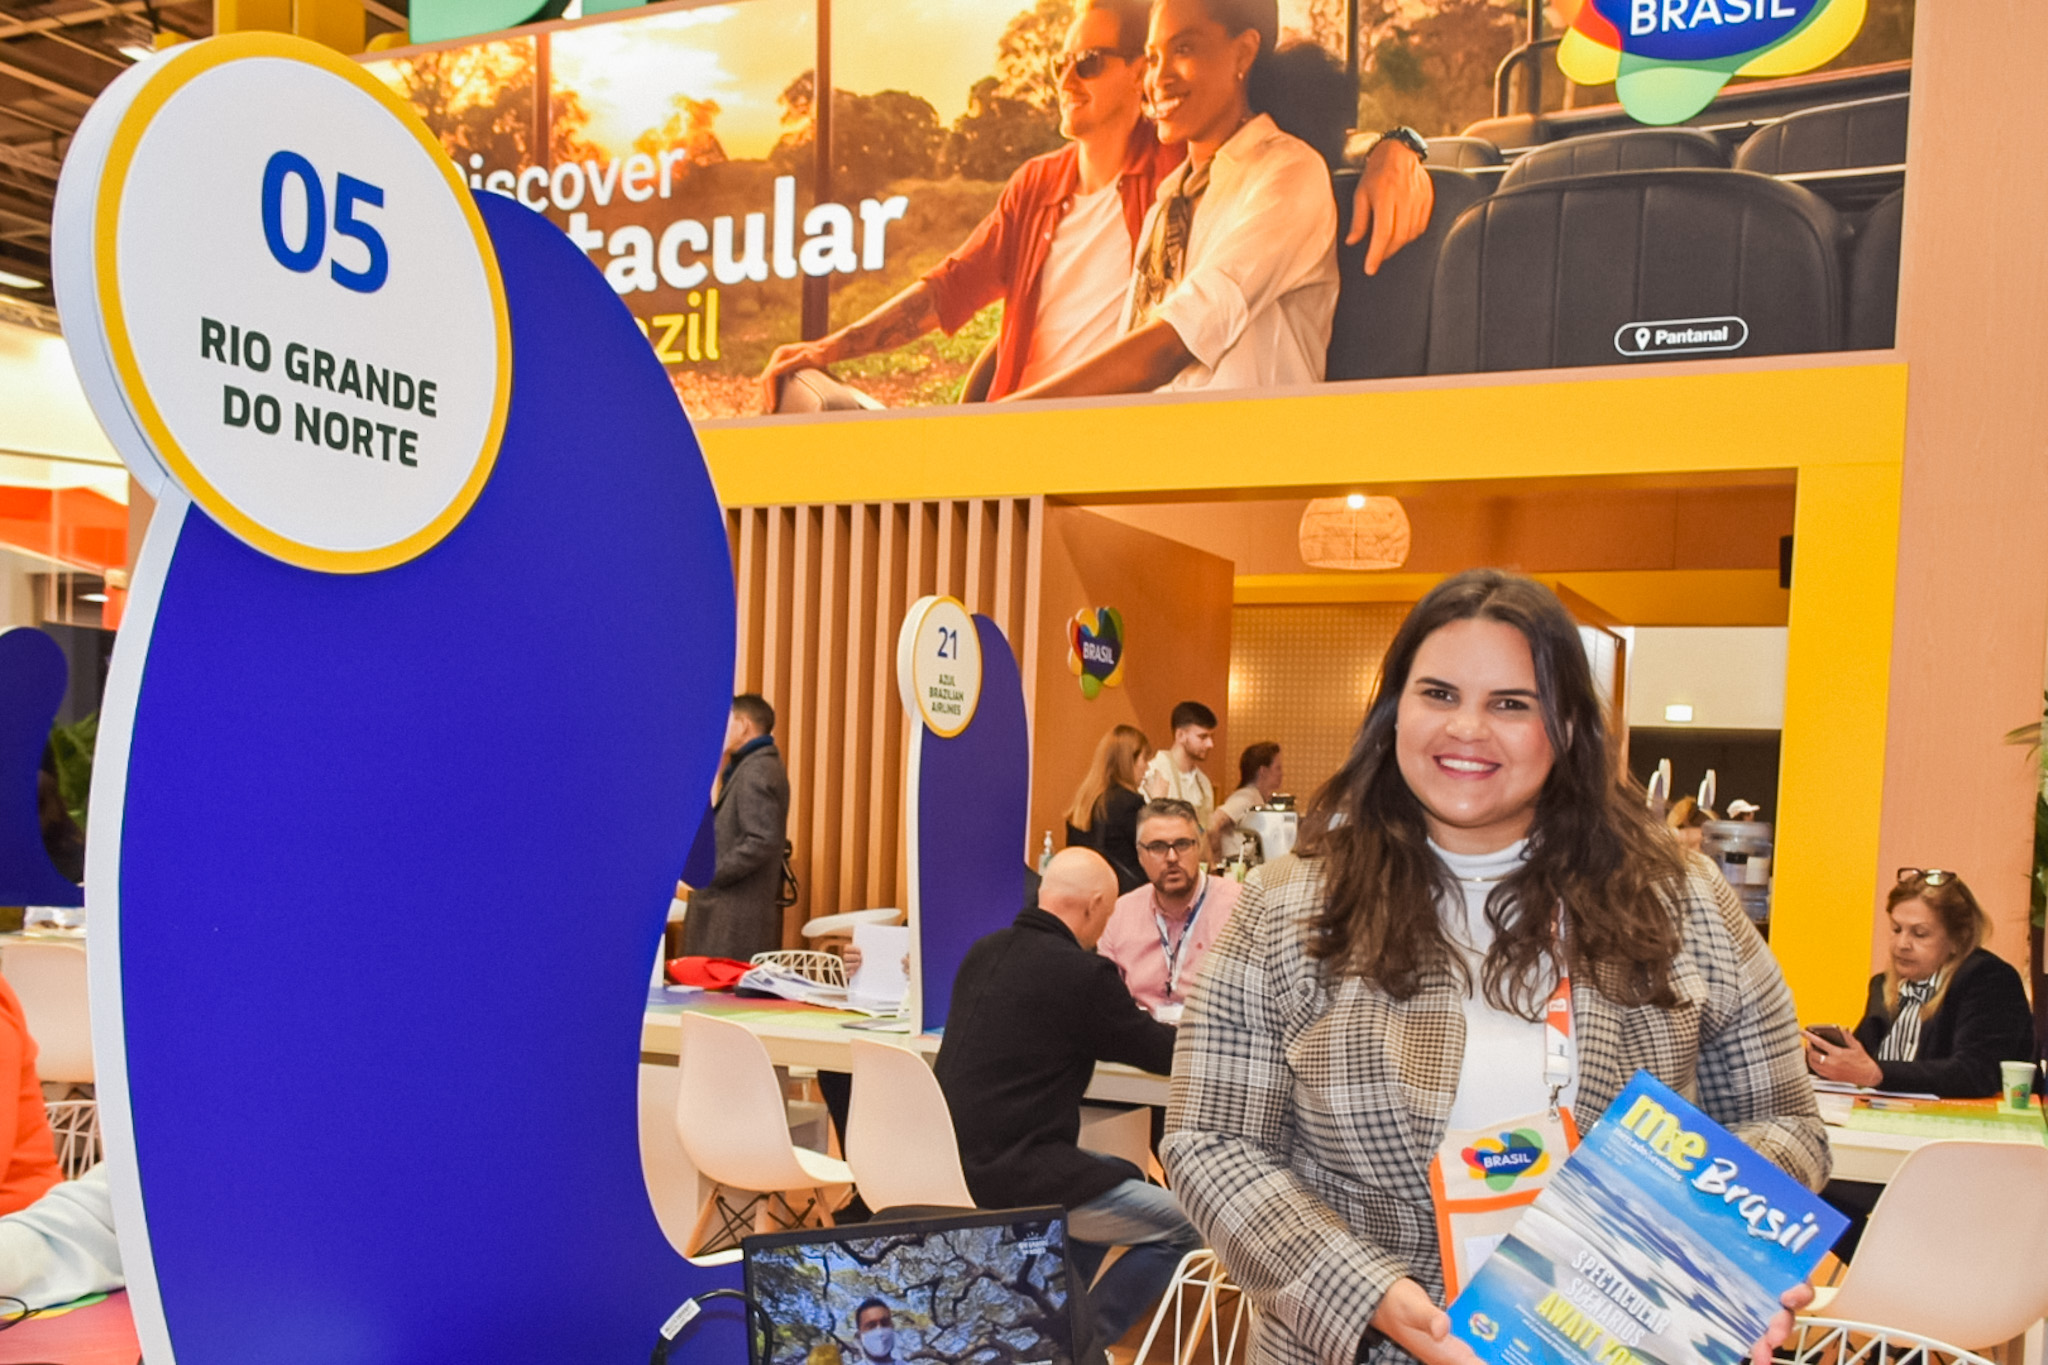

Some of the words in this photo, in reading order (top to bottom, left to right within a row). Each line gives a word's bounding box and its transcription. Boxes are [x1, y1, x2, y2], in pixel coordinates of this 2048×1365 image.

[451, 147, 685, 213] iscover
[261, 150, 389, 294] 05
[634, 288, 721, 365] zil
[1655, 325, 1729, 346] Pantanal
[201, 316, 271, 373] RIO
[285, 342, 437, 418] GRANDE
[223, 385, 281, 435] DO
[294, 402, 418, 467] NORTE
[937, 626, 957, 660] 21
[1082, 641, 1115, 665] BRASIL
[928, 686, 964, 702] BRAZILIAN
[931, 701, 962, 716] AIRLINES
[938, 673, 956, 687] AZUL
[1483, 1152, 1532, 1169] BRASIL
[1691, 1157, 1820, 1253] Brasil
[1534, 1292, 1604, 1350] AWAIT
[1565, 1278, 1646, 1347] SCENARIOS
[1571, 1250, 1671, 1335] SPECTACULAR
